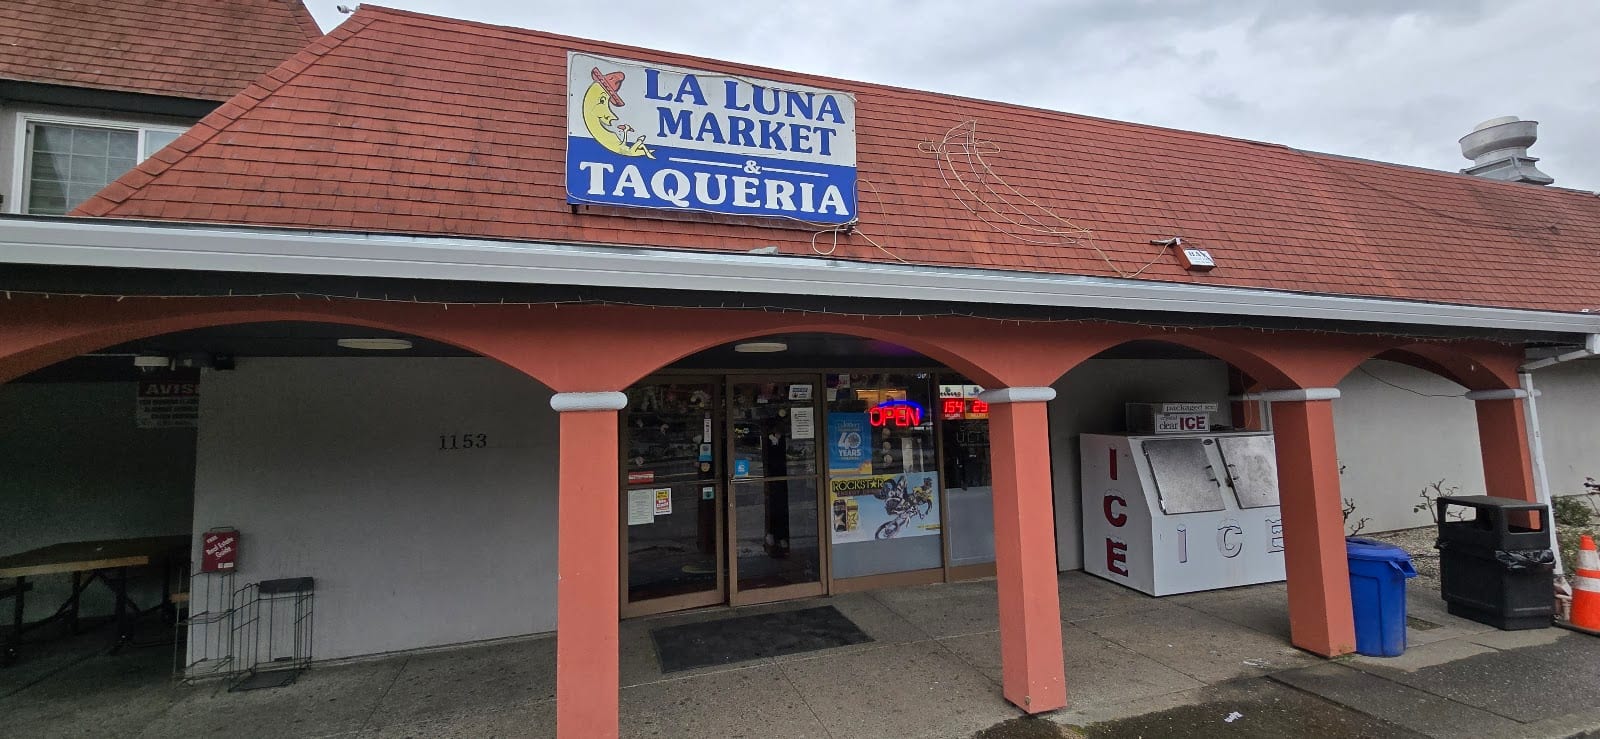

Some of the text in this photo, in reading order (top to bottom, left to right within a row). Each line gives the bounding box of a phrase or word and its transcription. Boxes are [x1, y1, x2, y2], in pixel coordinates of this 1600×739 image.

[644, 68, 845, 124] LA LUNA
[657, 106, 837, 156] MARKET
[743, 160, 762, 174] &
[579, 161, 849, 216] TAQUERIA
[944, 401, 964, 413] 154
[869, 407, 921, 427] OPEN
[1159, 421, 1178, 430] clear
[1180, 416, 1206, 430] ICE
[439, 433, 488, 450] 1153
[838, 431, 862, 449] 40
[838, 449, 862, 457] YEARS
[1103, 446, 1129, 578] ICE
